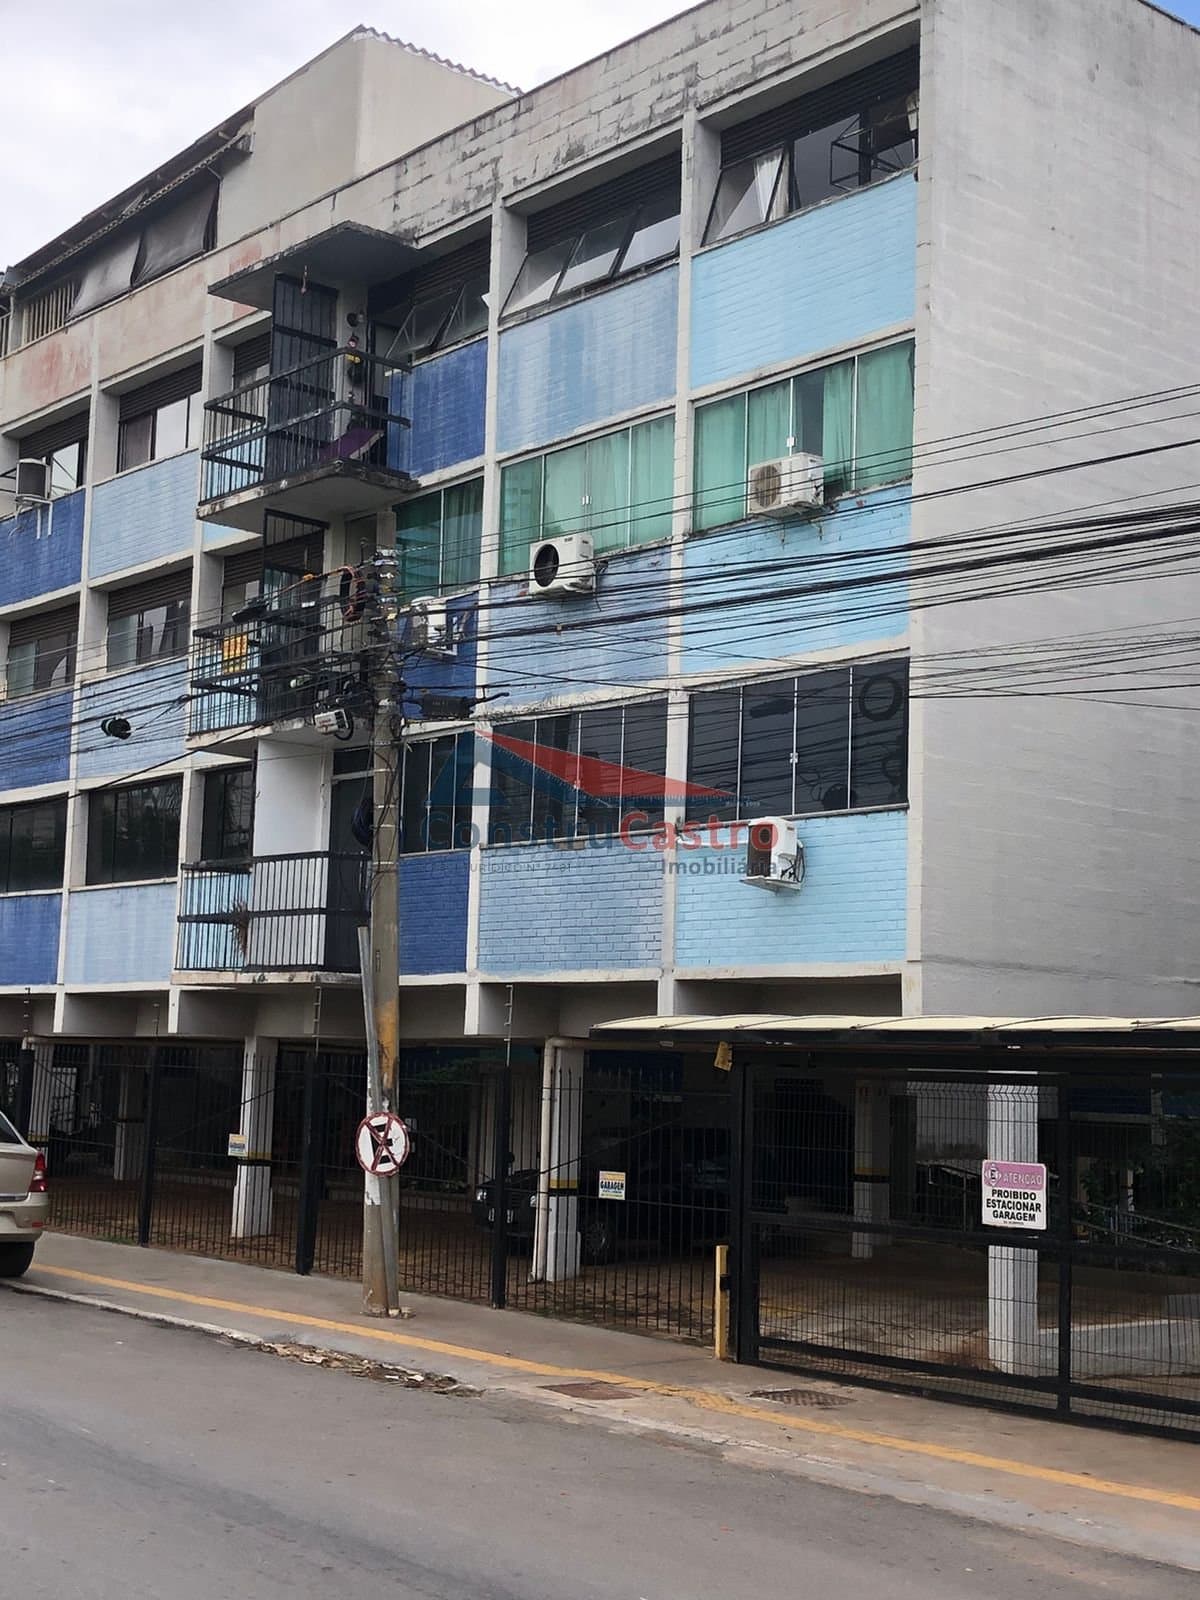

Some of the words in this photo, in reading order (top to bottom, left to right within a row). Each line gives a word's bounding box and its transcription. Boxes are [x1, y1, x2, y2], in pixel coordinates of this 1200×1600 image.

[992, 1189, 1036, 1200] PROIBIDO
[986, 1199, 1041, 1212] ESTACIONAR
[993, 1210, 1036, 1221] GARAGEM
